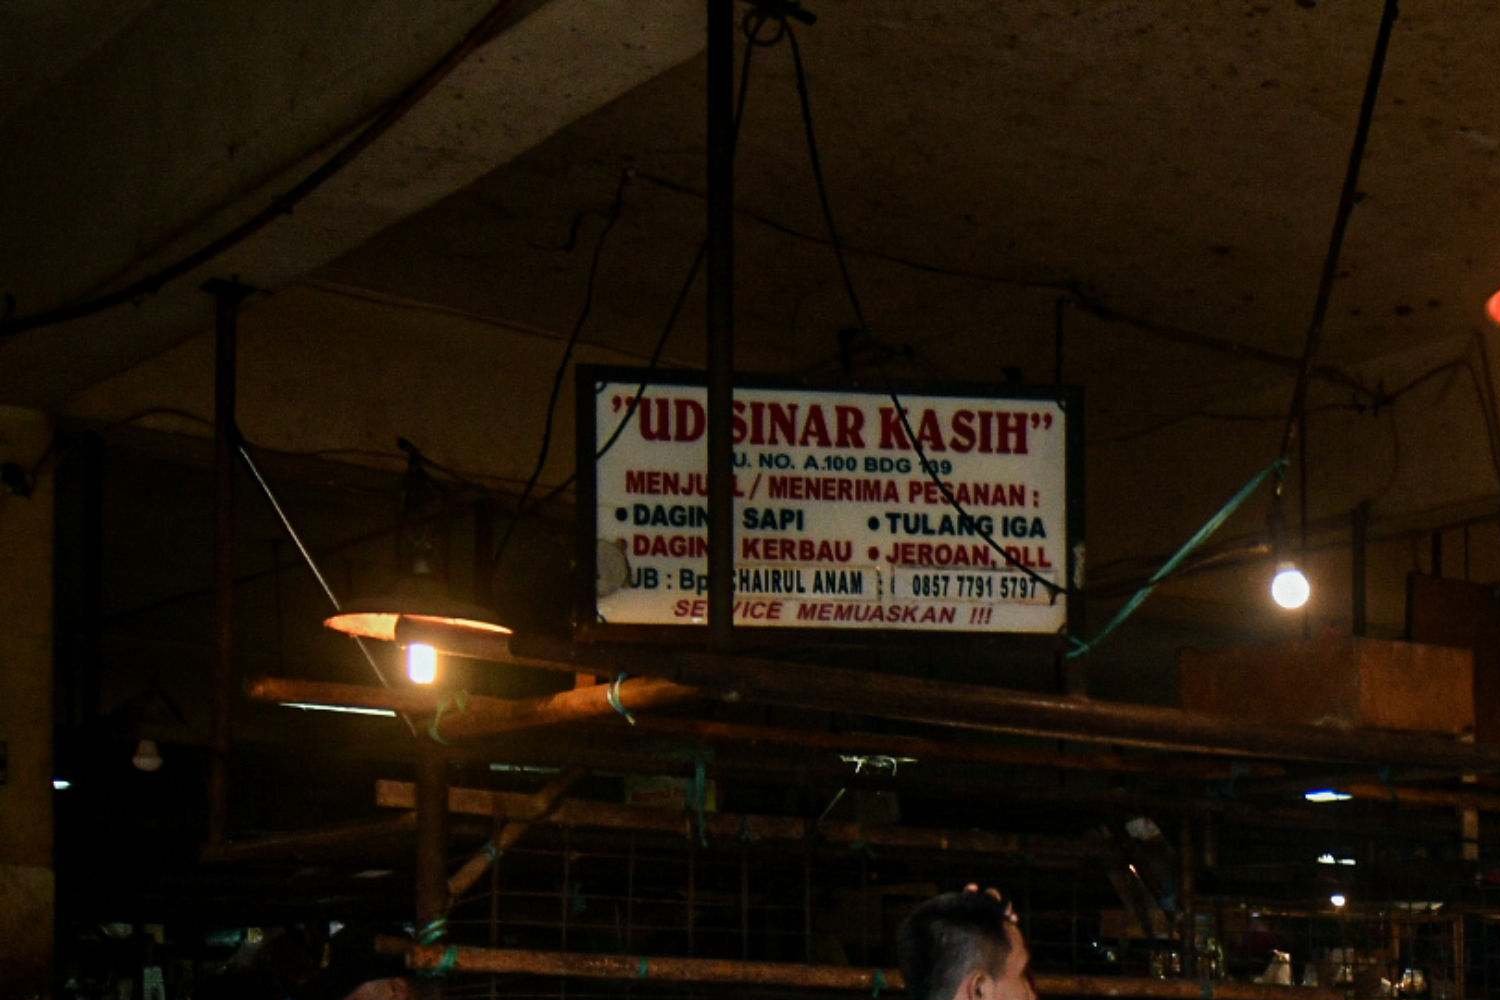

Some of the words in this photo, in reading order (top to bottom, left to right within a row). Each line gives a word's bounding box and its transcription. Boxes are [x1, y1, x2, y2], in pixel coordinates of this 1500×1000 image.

[759, 453, 795, 470] NO.
[864, 457, 912, 474] BDG
[626, 470, 744, 498] MENJUL
[768, 475, 900, 503] MENERIMA
[632, 504, 709, 528] DAGIN
[742, 507, 804, 531] SAPI
[885, 512, 994, 538] TULANG
[1002, 515, 1047, 538] IGA
[632, 535, 709, 558] DAGIN
[742, 537, 853, 563] KERBAU
[885, 542, 996, 569] JEROAN,
[1004, 545, 1052, 568] DLL
[629, 567, 659, 590] UB
[812, 570, 862, 595] ANAM
[912, 573, 950, 597] 0857
[956, 575, 993, 598] 7791
[1000, 576, 1036, 599] 5797
[674, 600, 783, 620] SEICE
[796, 602, 956, 625] MEMUASKAN
[969, 606, 993, 625] !!!
